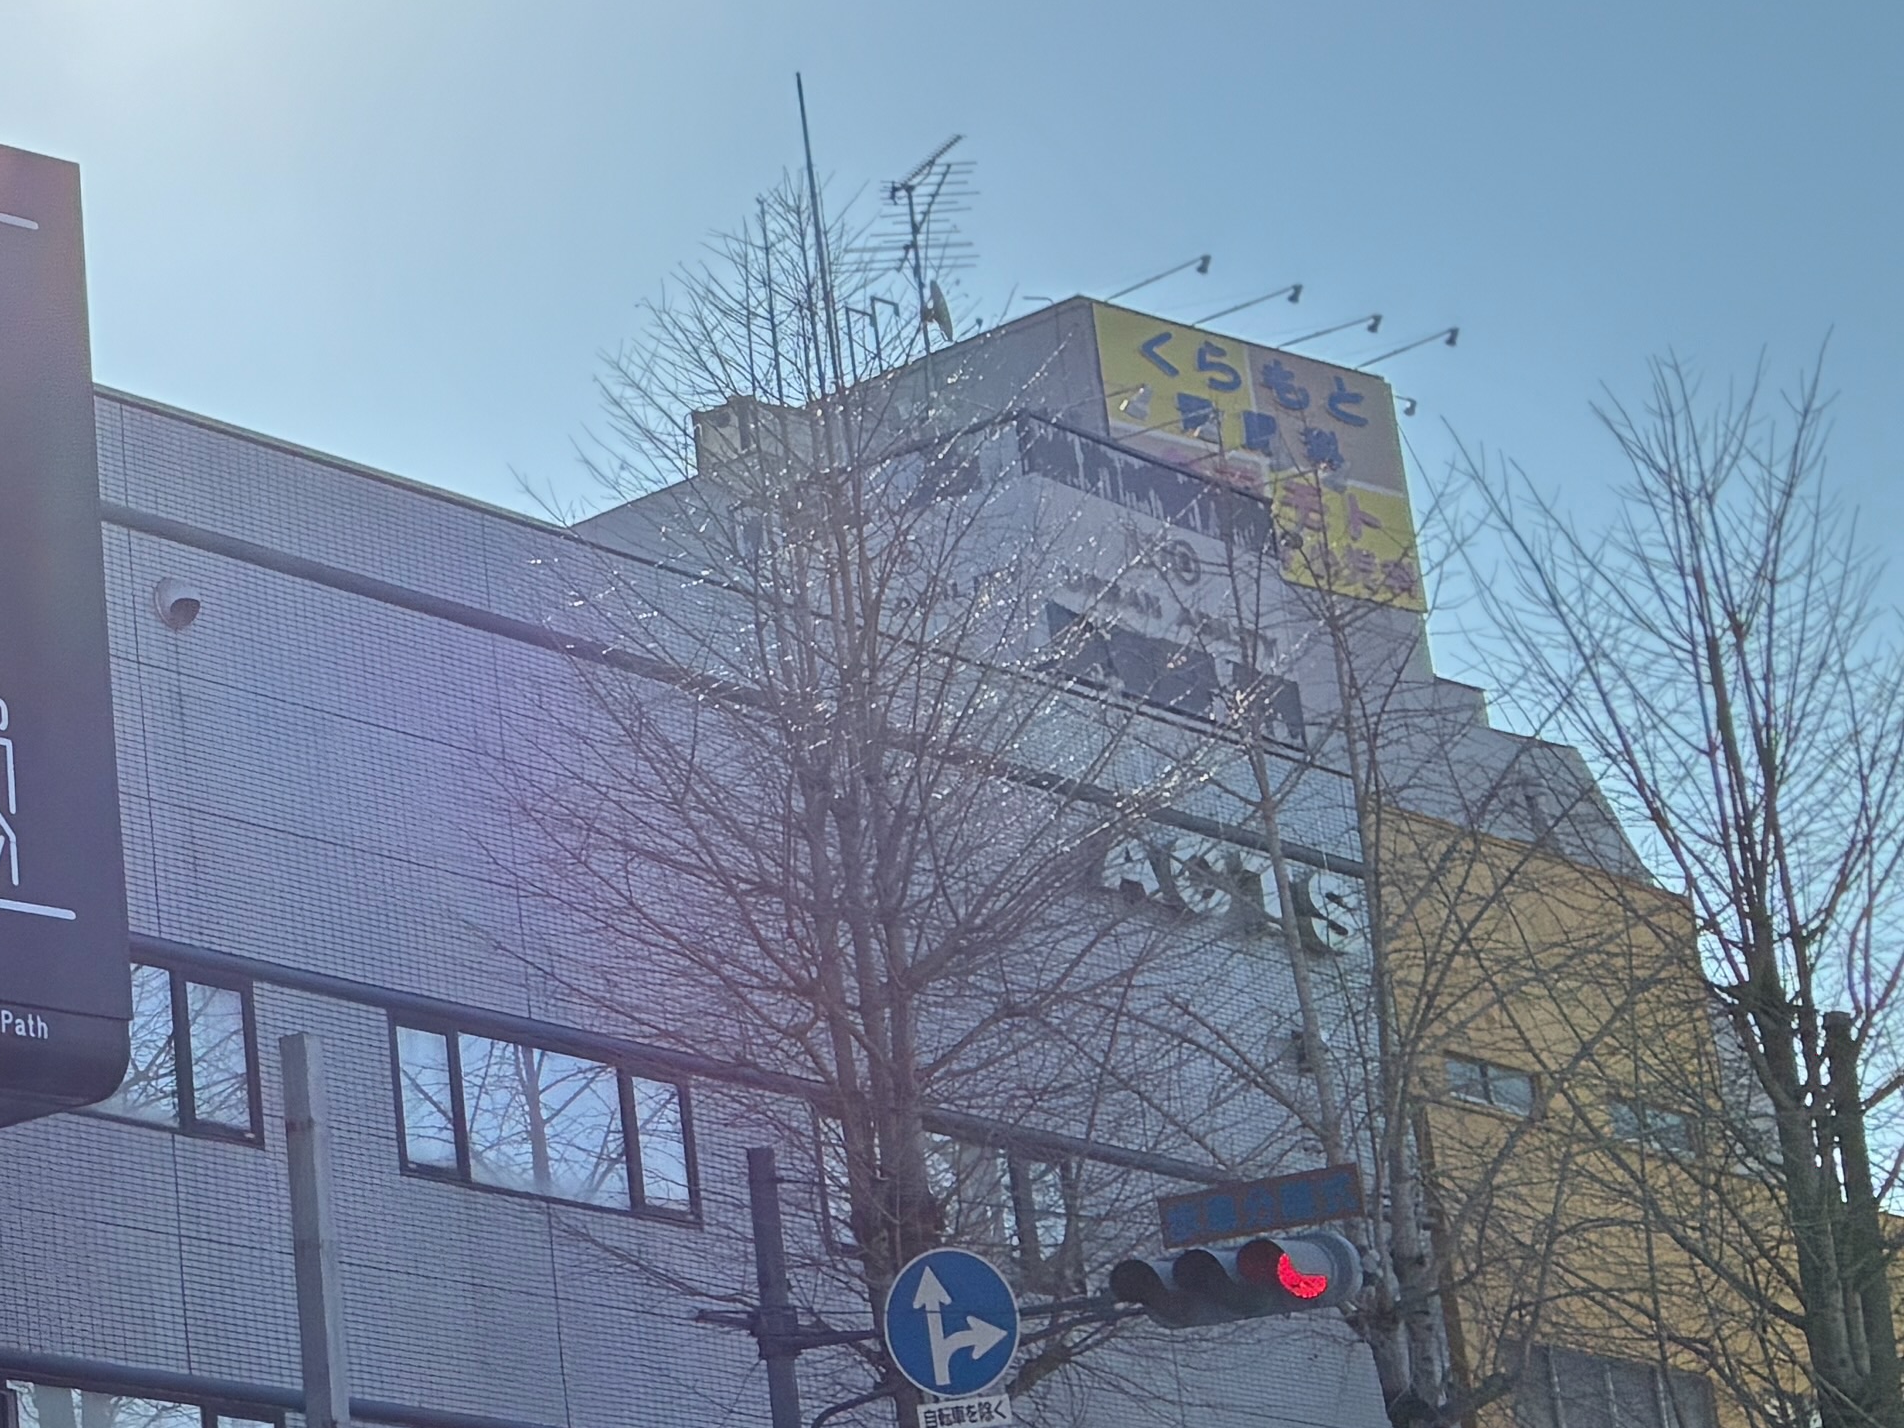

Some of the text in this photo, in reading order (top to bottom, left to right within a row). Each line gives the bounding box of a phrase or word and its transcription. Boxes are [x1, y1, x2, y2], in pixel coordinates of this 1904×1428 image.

[1140, 330, 1369, 429] くらもと
[1, 1008, 50, 1042] Path
